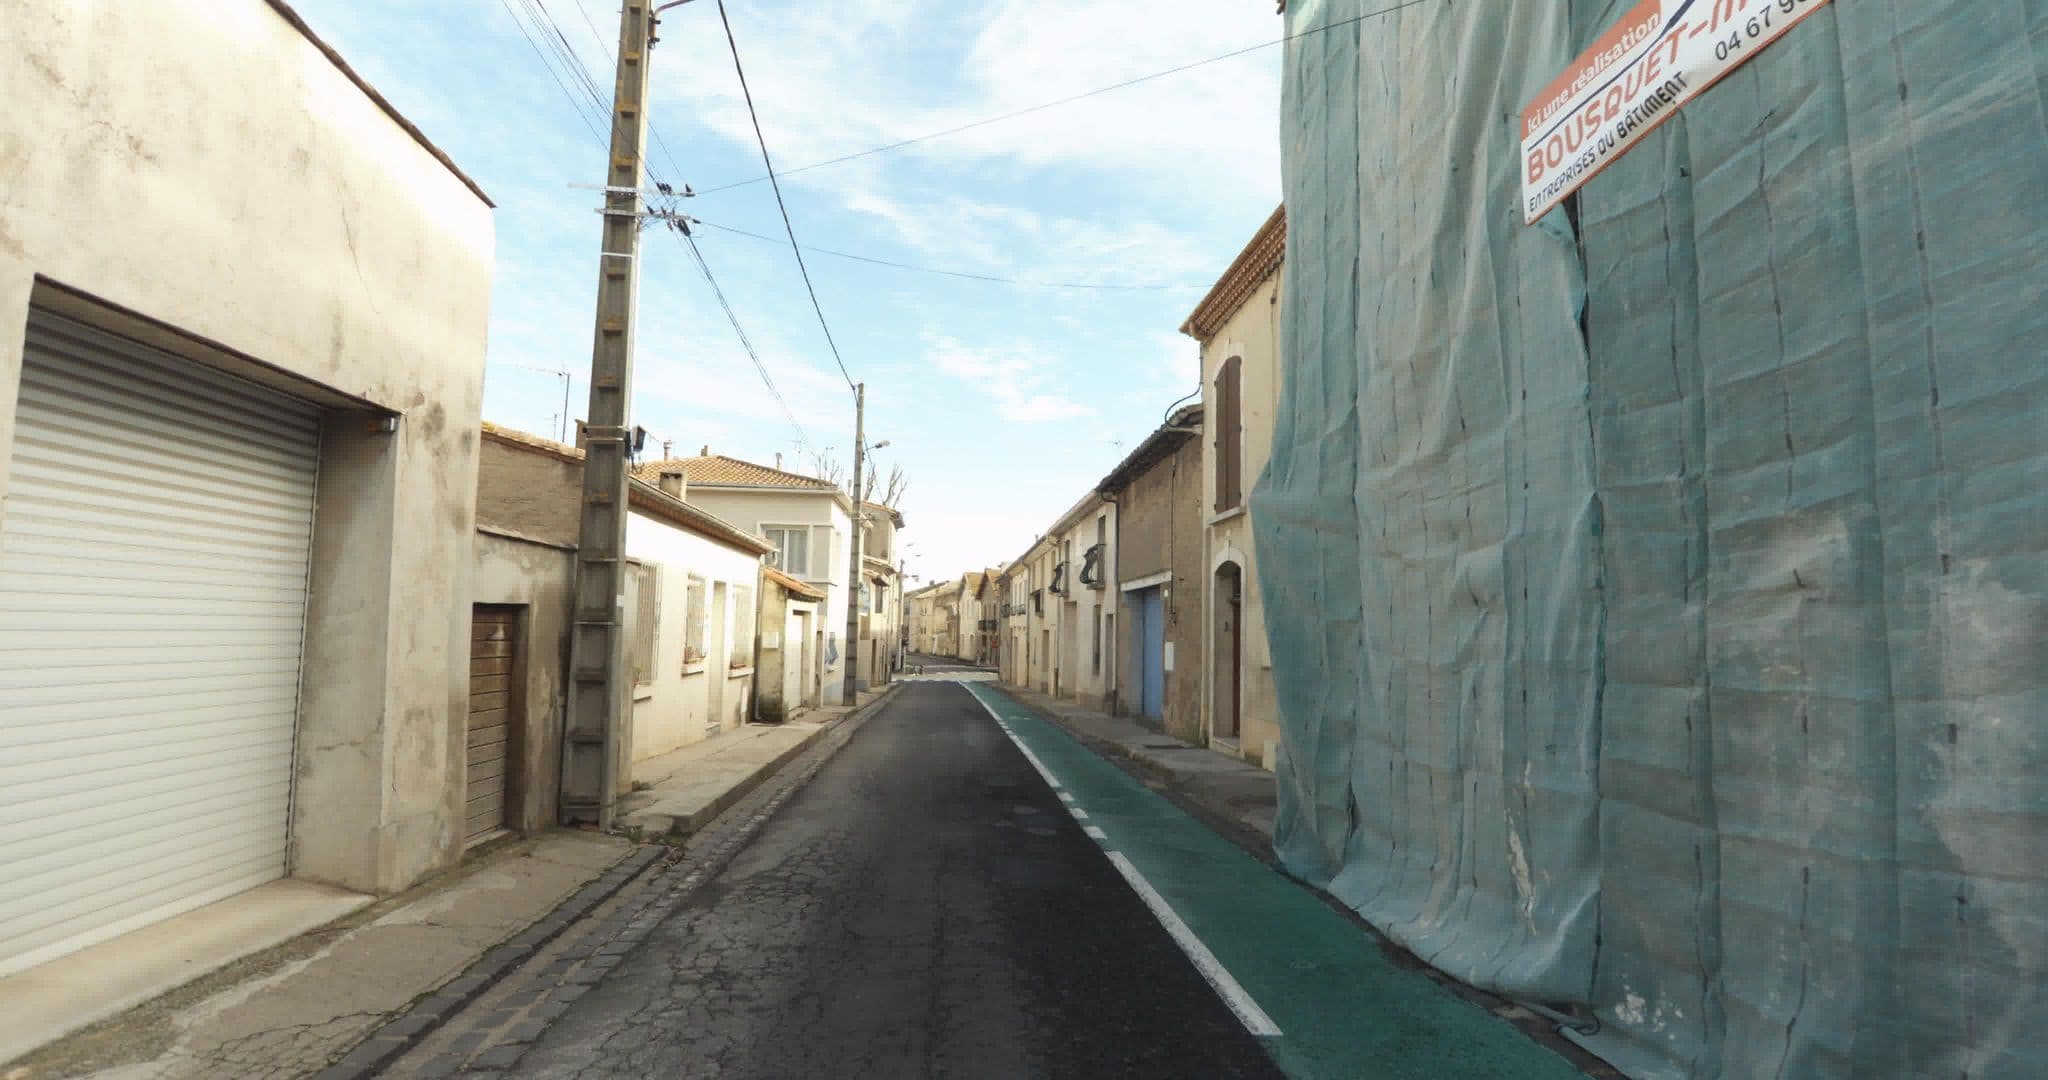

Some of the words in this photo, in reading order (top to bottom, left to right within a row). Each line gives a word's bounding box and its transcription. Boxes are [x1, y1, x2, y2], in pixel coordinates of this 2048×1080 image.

[1528, 107, 1541, 133] Ici
[1543, 88, 1569, 117] une
[1571, 12, 1660, 93] réalisation
[1715, 31, 1742, 61] 04
[1746, 5, 1772, 38] 67
[1778, 0, 1808, 14] 9
[1530, 147, 1596, 212] ENTREPRISES
[1598, 133, 1615, 156] DU
[1616, 71, 1688, 139] BÂTIMENT
